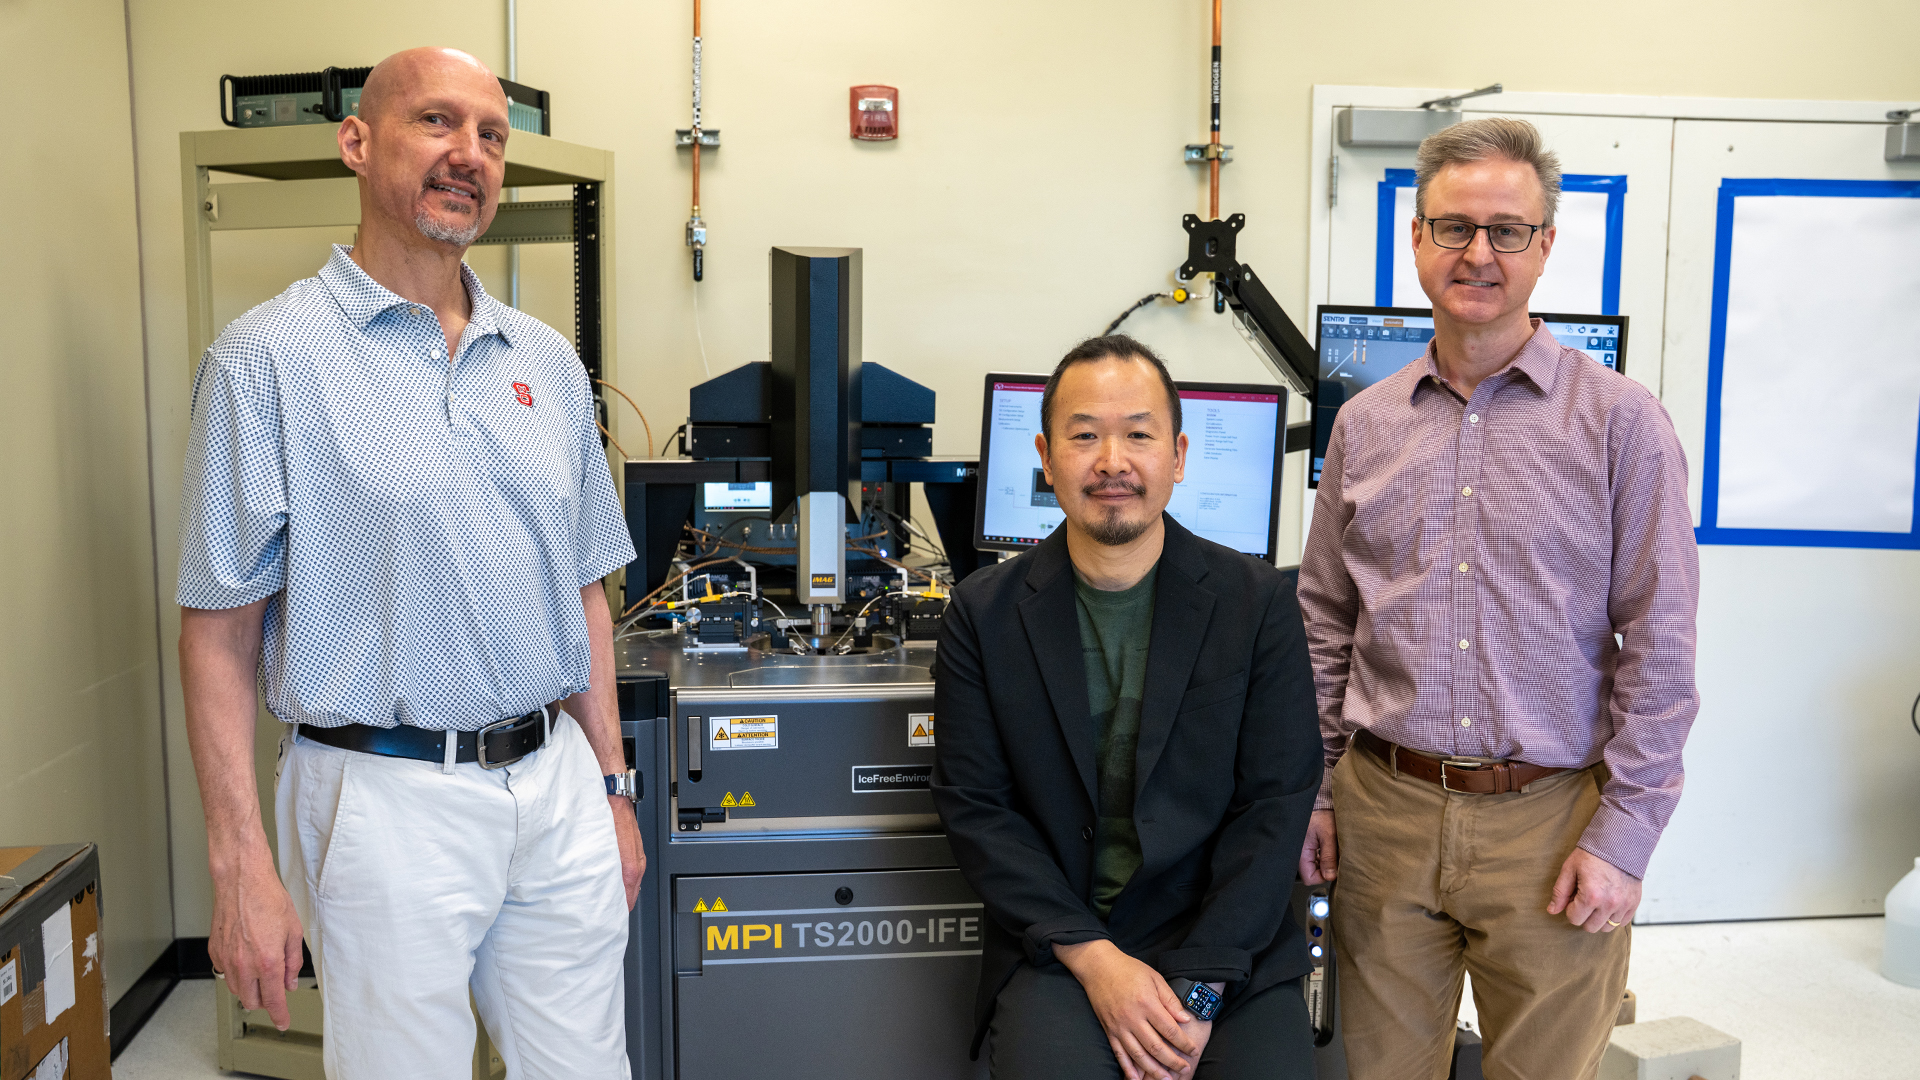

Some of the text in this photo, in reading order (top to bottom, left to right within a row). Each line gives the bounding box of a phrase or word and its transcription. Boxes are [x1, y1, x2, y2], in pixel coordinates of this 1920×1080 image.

[1212, 61, 1220, 104] NITROGEN
[706, 916, 979, 950] MPI TS2000-IFE
